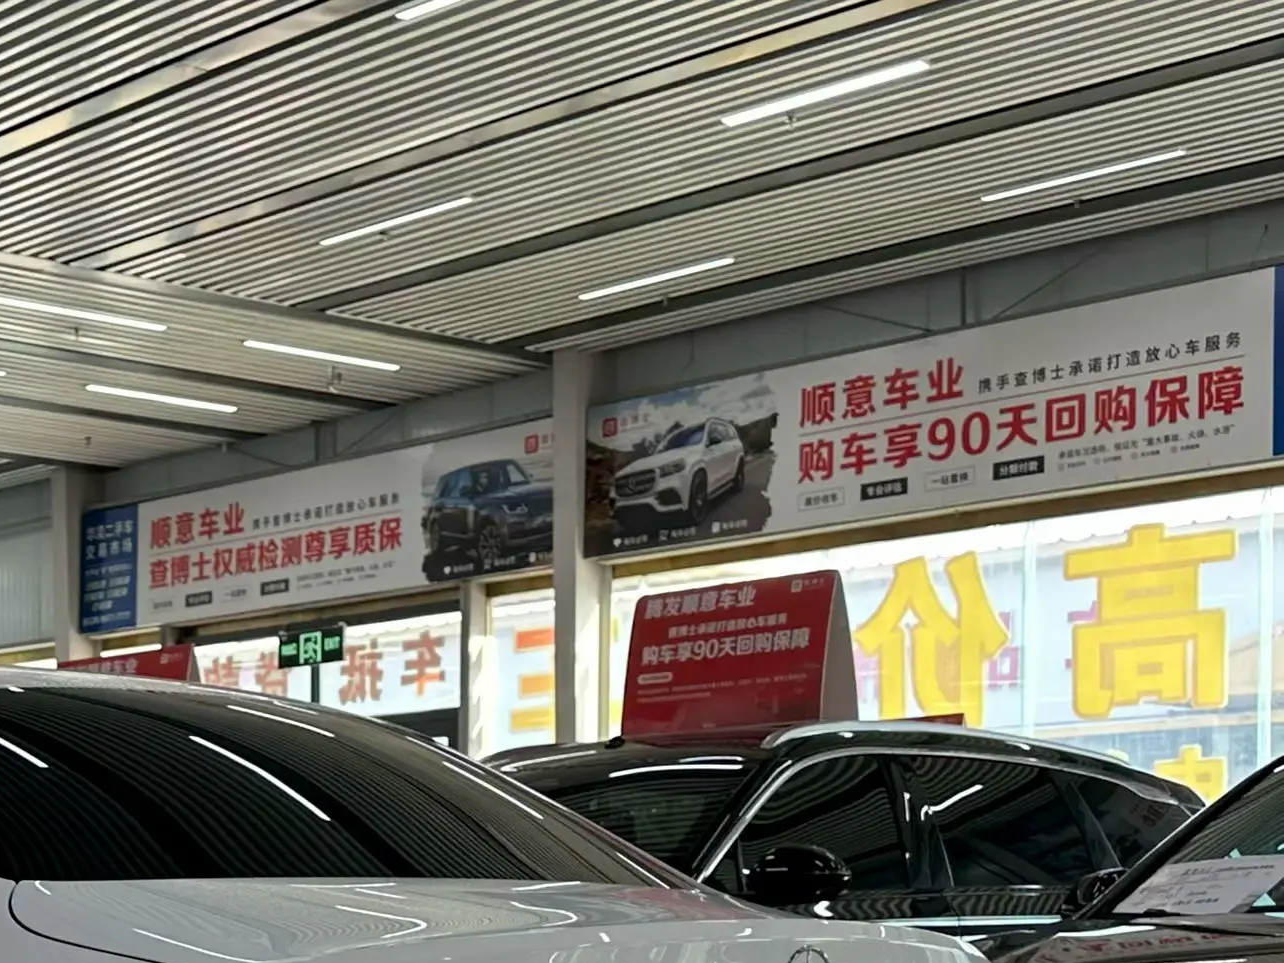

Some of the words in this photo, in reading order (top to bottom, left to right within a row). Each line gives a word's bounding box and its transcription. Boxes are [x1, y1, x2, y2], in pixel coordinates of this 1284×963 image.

[799, 357, 964, 428] 顺意车业
[978, 331, 1241, 394] 携手查博士承诺打造放心车服务
[797, 366, 1244, 484] 购车享90天回购保障
[149, 516, 402, 589] 查博士权威检测尊享质保
[150, 501, 245, 549] 顺意车业
[641, 628, 810, 666] 购车享90天回购保障
